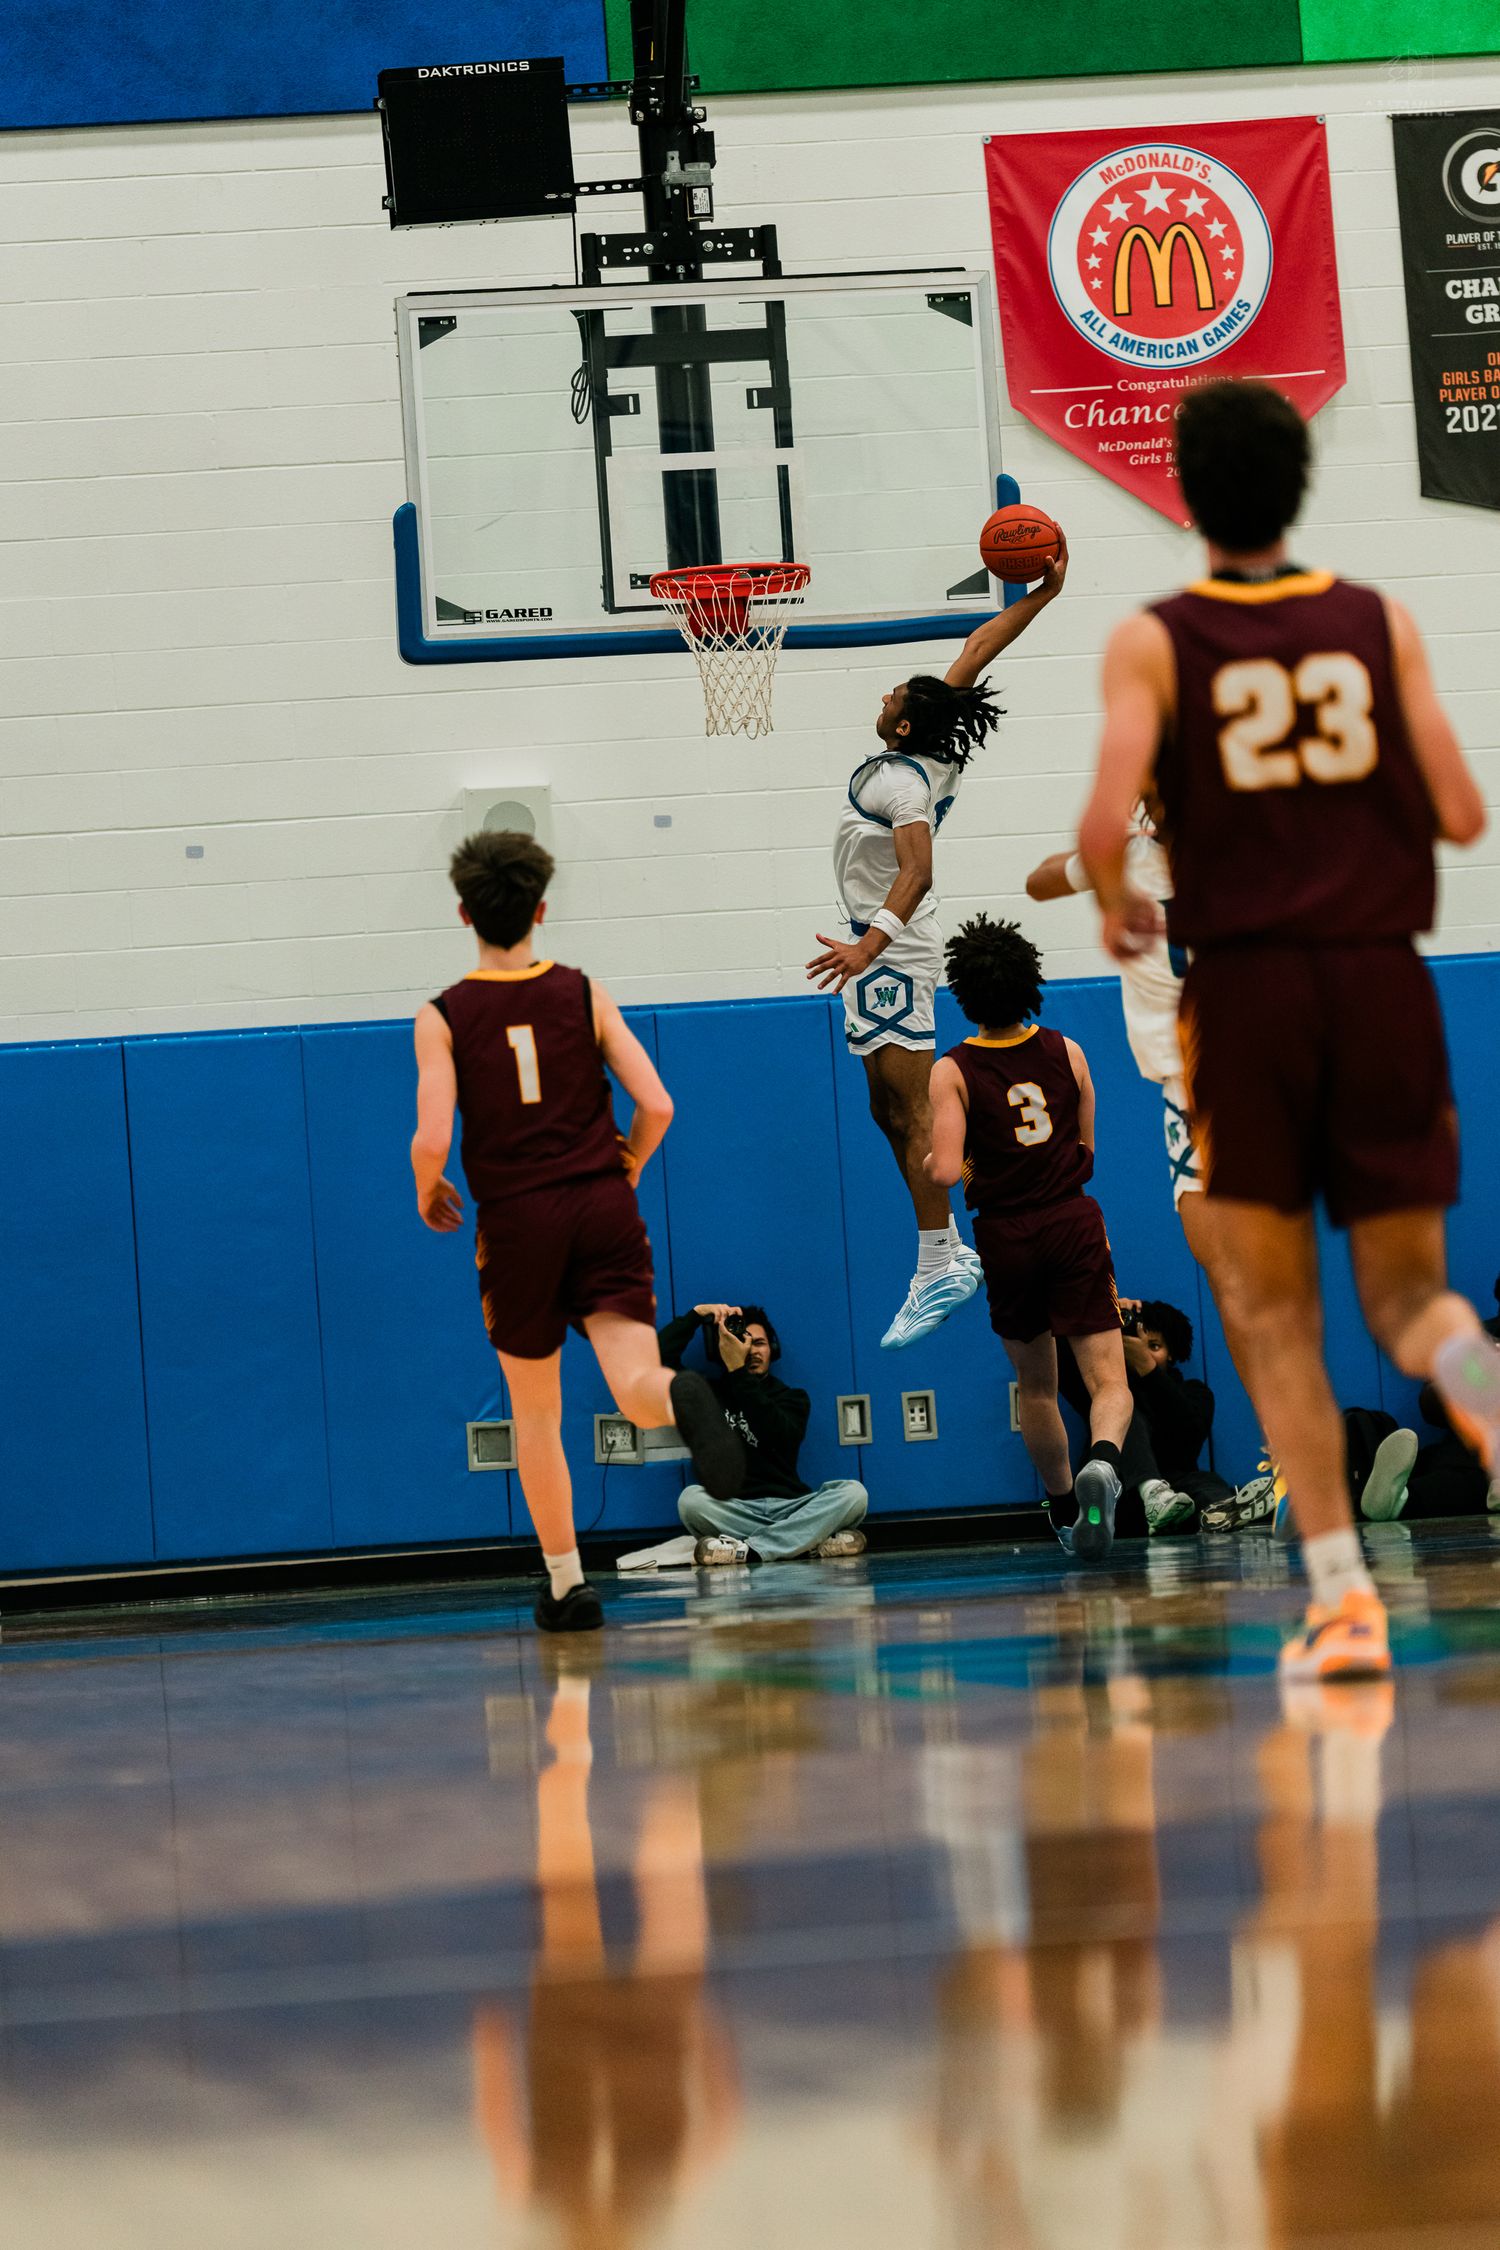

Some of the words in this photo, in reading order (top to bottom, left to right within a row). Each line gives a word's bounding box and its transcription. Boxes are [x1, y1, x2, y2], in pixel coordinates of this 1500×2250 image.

[418, 61, 530, 78] DAKTRONICS
[1099, 152, 1212, 185] McDONALD'S
[1446, 232, 1481, 245] PLAYER
[1483, 231, 1496, 242] OF
[1445, 277, 1500, 299] CHA
[1080, 309, 1106, 338] ALL
[1108, 332, 1200, 358] AMERICAN
[1203, 299, 1252, 347] GAMES
[1117, 375, 1233, 393] Congratulations
[1442, 371, 1480, 385] GIRLS
[1439, 386, 1487, 402] PLAYER
[1445, 404, 1500, 433] 202
[1098, 438, 1173, 453] McDonald's
[1129, 453, 1161, 465] Girls
[993, 523, 1042, 545] Rawlings
[485, 607, 553, 619] GARED
[1210, 651, 1380, 792] 23
[505, 1024, 542, 1104] 1
[1006, 1081, 1053, 1147] 3
